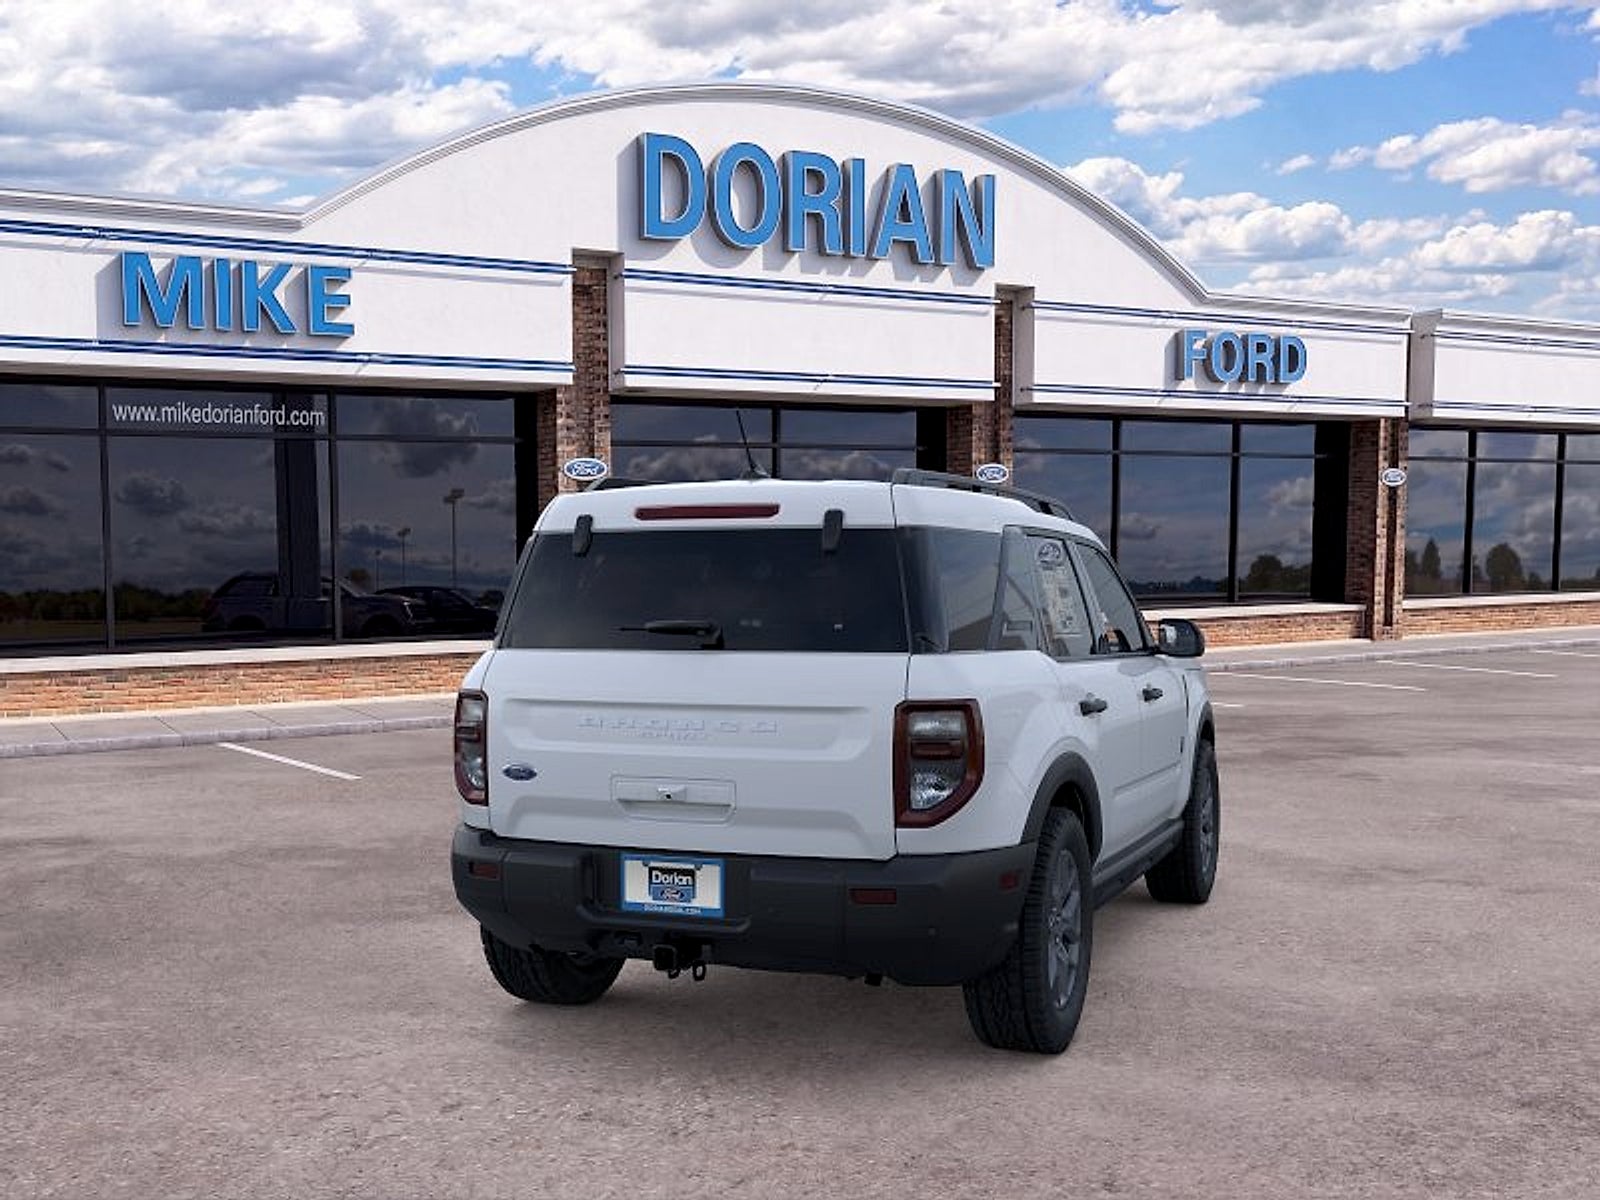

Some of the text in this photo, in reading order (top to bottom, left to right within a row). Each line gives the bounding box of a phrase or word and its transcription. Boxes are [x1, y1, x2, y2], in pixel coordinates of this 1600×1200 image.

[640, 132, 996, 270] DORIAN
[120, 251, 355, 338] MIKE
[1177, 328, 1308, 384] FORD
[112, 401, 326, 427] www.mikedorianford.com
[651, 870, 692, 885] Dorian
